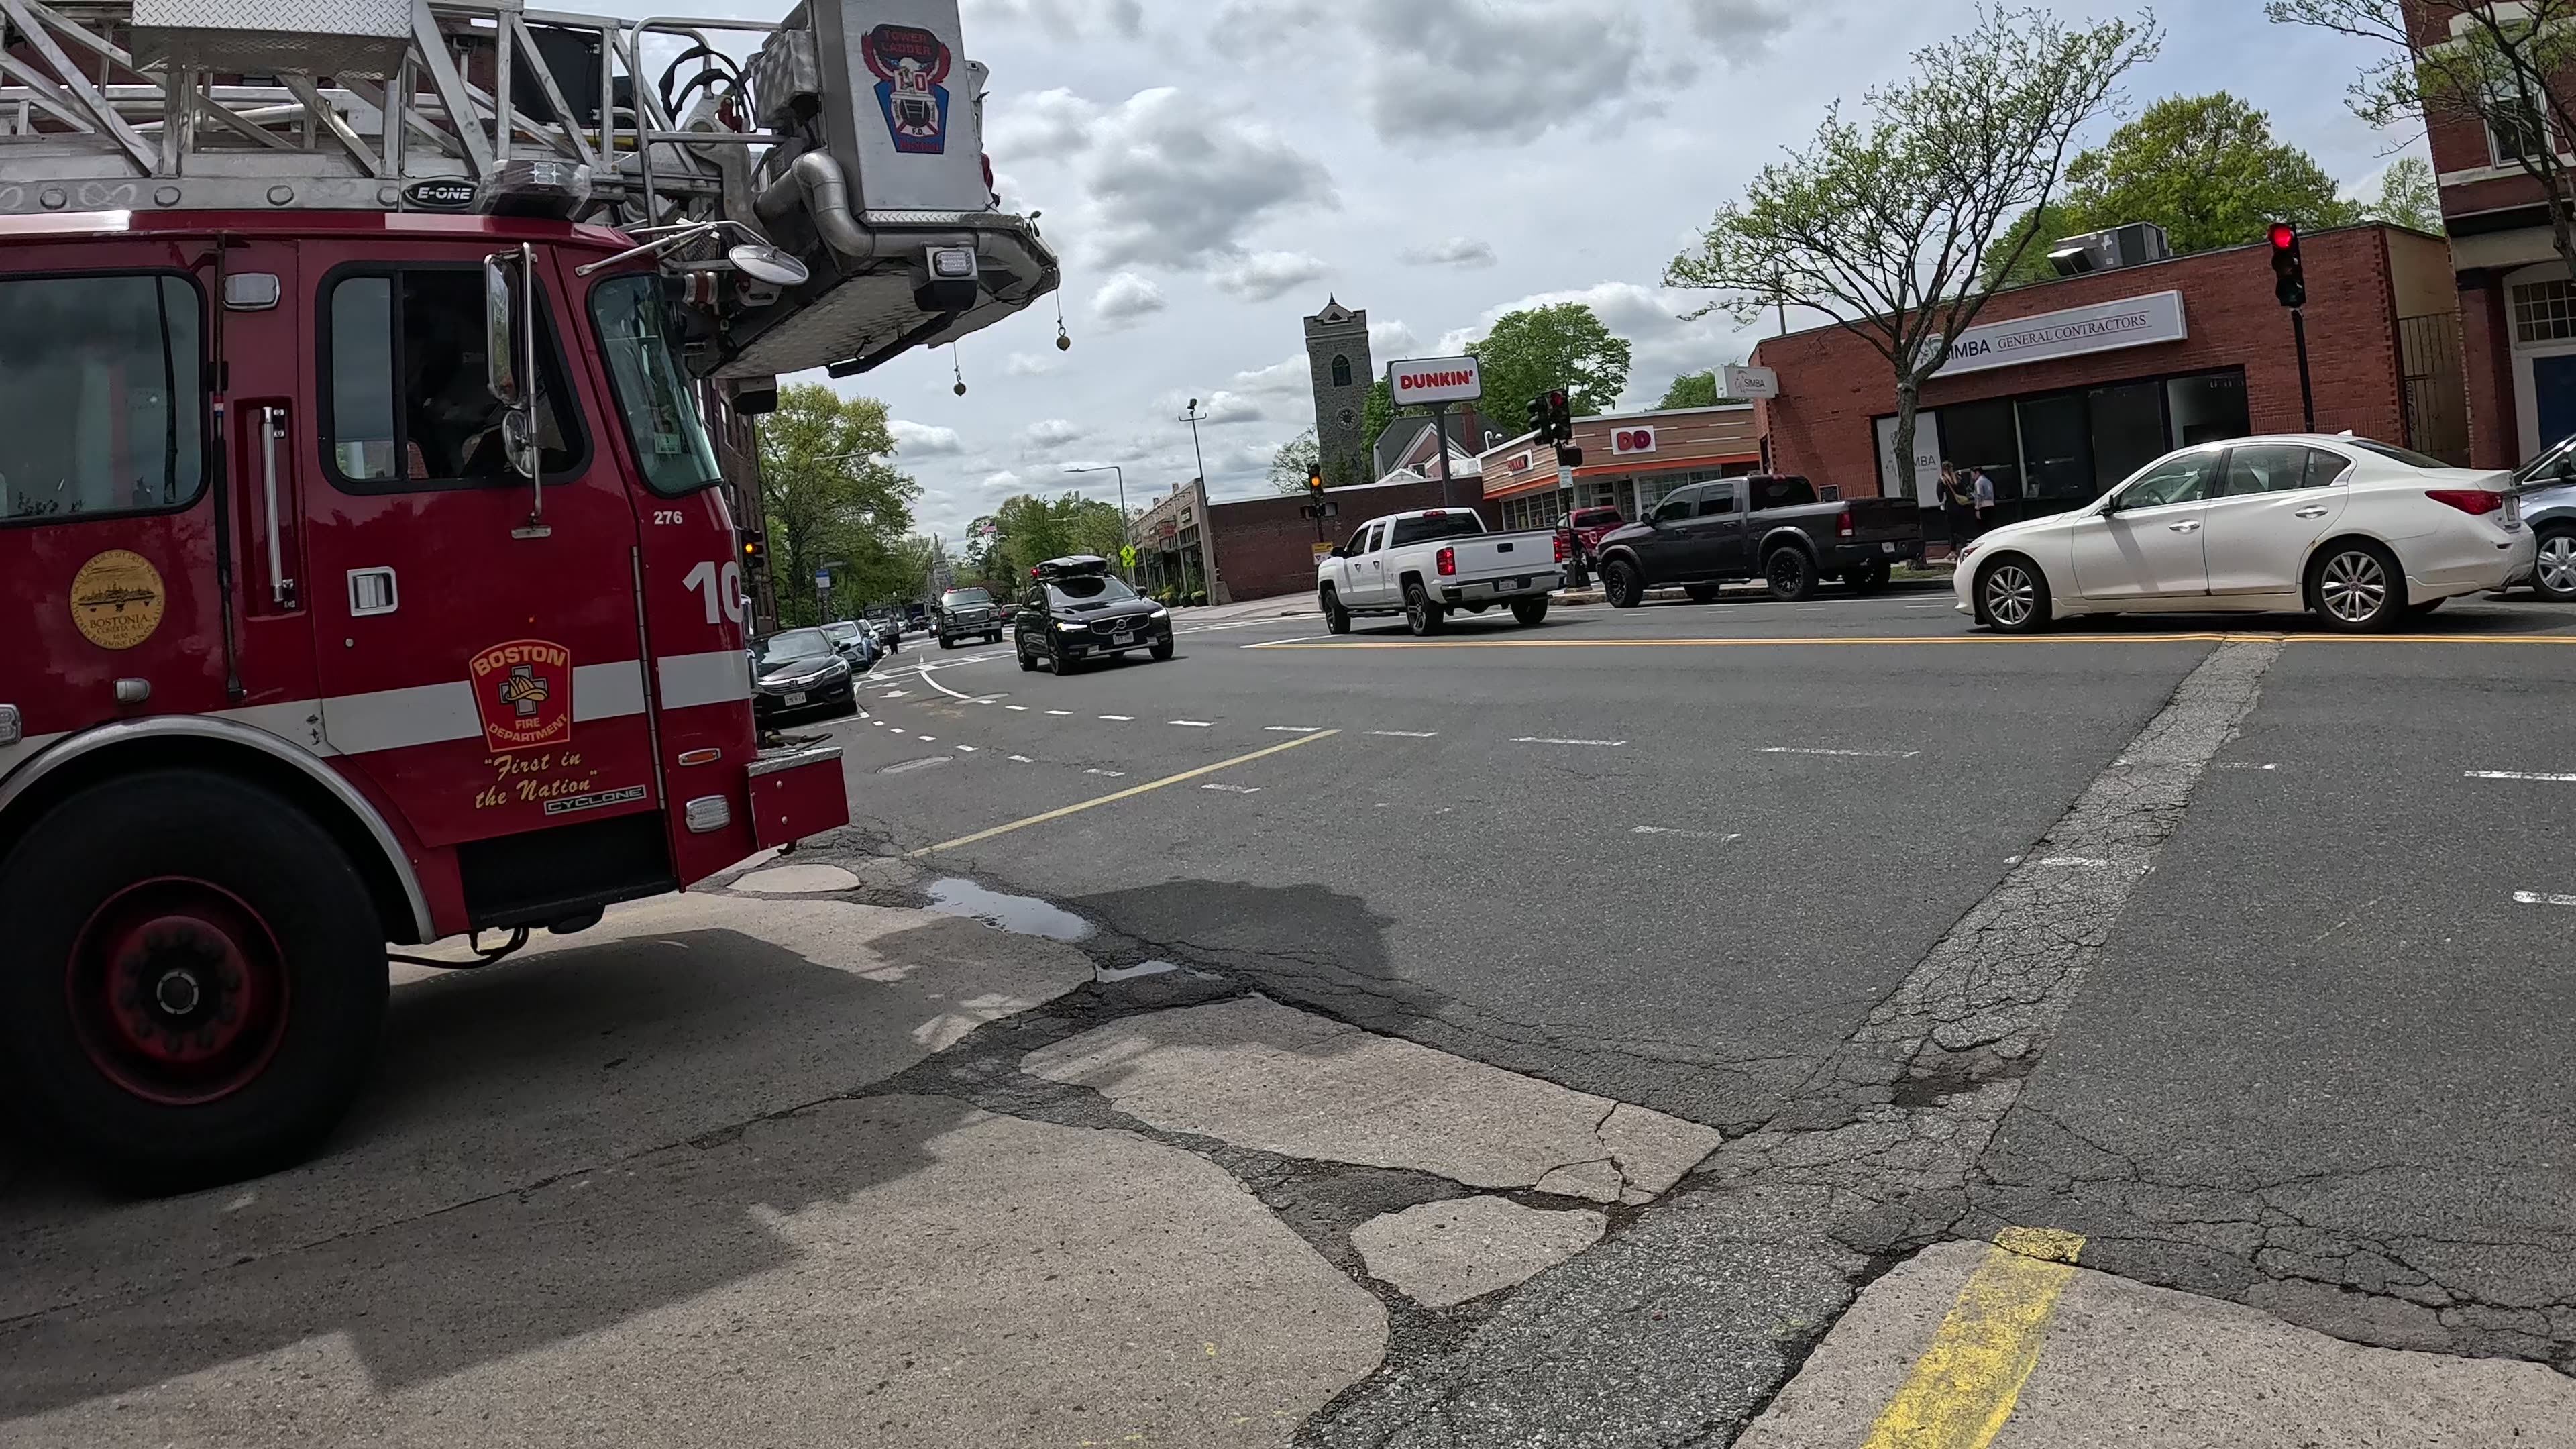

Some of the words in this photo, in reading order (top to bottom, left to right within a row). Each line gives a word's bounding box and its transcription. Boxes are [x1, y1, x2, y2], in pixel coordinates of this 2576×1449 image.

[885, 30, 926, 43] TOWER
[881, 42, 933, 55] LADDER
[417, 186, 472, 199] E-ONE
[1998, 331, 2053, 350] GENERAL
[2055, 314, 2147, 339] CONTRACTORS
[1400, 370, 1473, 389] DUNKIN'
[1744, 378, 1766, 387] SIMBA
[1617, 430, 1651, 451] DD
[653, 511, 683, 525] 276
[682, 561, 744, 624] 10
[473, 645, 566, 677] BOSTON
[488, 713, 568, 742] DEPARTMENT
[515, 717, 541, 730] FIRE
[561, 751, 582, 767] in
[475, 785, 508, 809] the
[547, 788, 642, 812] CYCLONE
